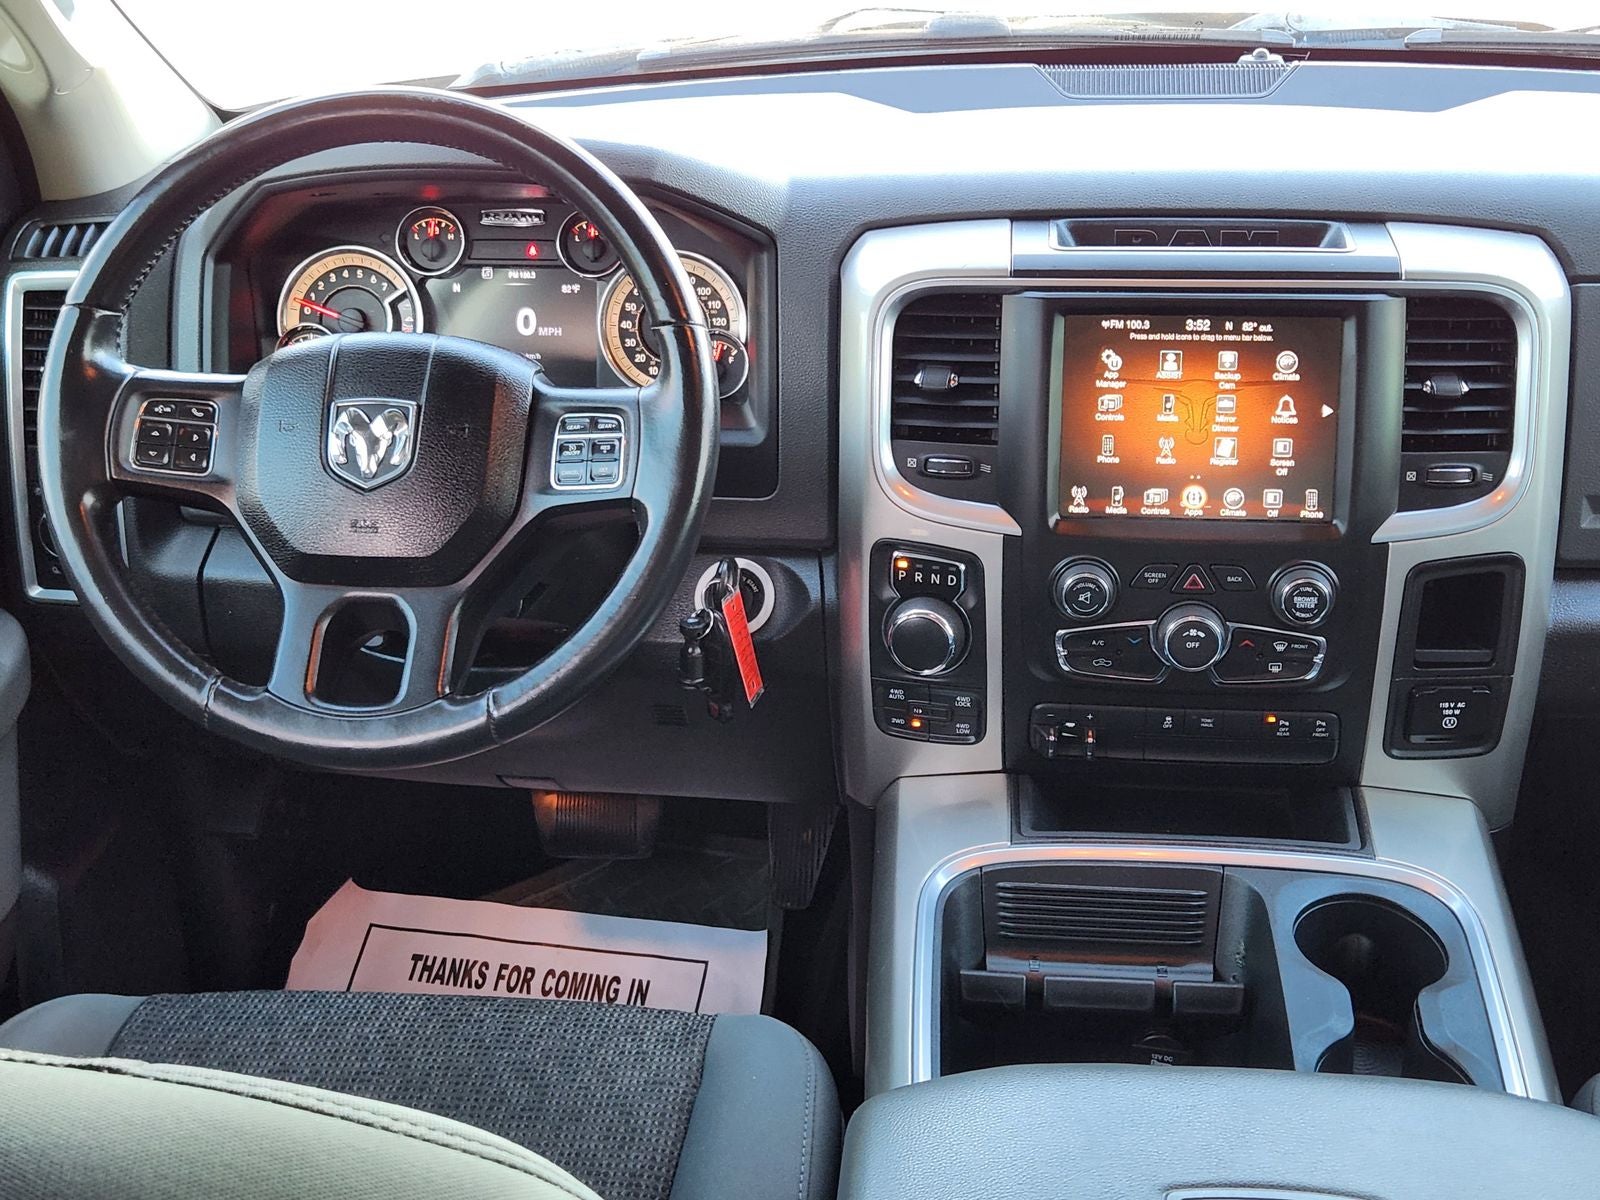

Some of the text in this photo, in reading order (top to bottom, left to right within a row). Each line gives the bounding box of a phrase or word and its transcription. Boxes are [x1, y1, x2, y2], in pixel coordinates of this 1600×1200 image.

[329, 273, 337, 282] 3
[342, 269, 349, 278] 4
[356, 269, 364, 278] 5
[370, 275, 377, 284] 6
[317, 281, 325, 291] 2
[381, 282, 389, 292] 7
[452, 282, 461, 293] N
[696, 287, 712, 296] 100
[310, 292, 316, 301] 1
[625, 302, 637, 311] 50
[707, 300, 721, 309] 110
[303, 305, 312, 315] 0
[516, 307, 562, 336] 0 MPH
[620, 320, 632, 329] 40
[712, 317, 727, 326] 120
[1110, 320, 1151, 330] FM 100.3
[1185, 319, 1211, 331] 3:52
[1225, 321, 1233, 331] N
[1129, 332, 1148, 340] Press
[1161, 332, 1175, 341] hold
[1193, 333, 1200, 341] to
[1200, 334, 1216, 342] drag
[624, 338, 637, 347] 30
[634, 353, 646, 362] 20
[728, 356, 735, 364] F
[648, 366, 659, 375] 10
[1103, 370, 1119, 379] App
[1214, 372, 1241, 381] Backup
[1272, 373, 1301, 381] Climate
[1095, 379, 1127, 389] Manager
[1218, 382, 1236, 390] Cam
[1095, 413, 1125, 421] Controls
[1156, 414, 1179, 422] Media
[1215, 415, 1238, 423] Mirror
[1270, 415, 1299, 424] Notices
[1211, 424, 1240, 432] Dimmer
[1096, 455, 1120, 463] Phone
[1155, 456, 1177, 464] Radio
[1270, 458, 1295, 467] Screen
[1275, 467, 1289, 476] Off
[1068, 505, 1090, 514] Radio
[1105, 506, 1128, 514] Media
[1140, 507, 1171, 515] Controls
[1184, 507, 1204, 517] Apps
[1220, 509, 1247, 517] Climate
[1266, 509, 1279, 517] Off
[1300, 510, 1324, 519] Phone
[898, 571, 957, 586] P R N D
[1227, 575, 1243, 583] BACK
[1076, 582, 1097, 590] VOLUME
[1185, 641, 1201, 649] OFF
[408, 953, 651, 1007] THANKS FOR COMING IN
